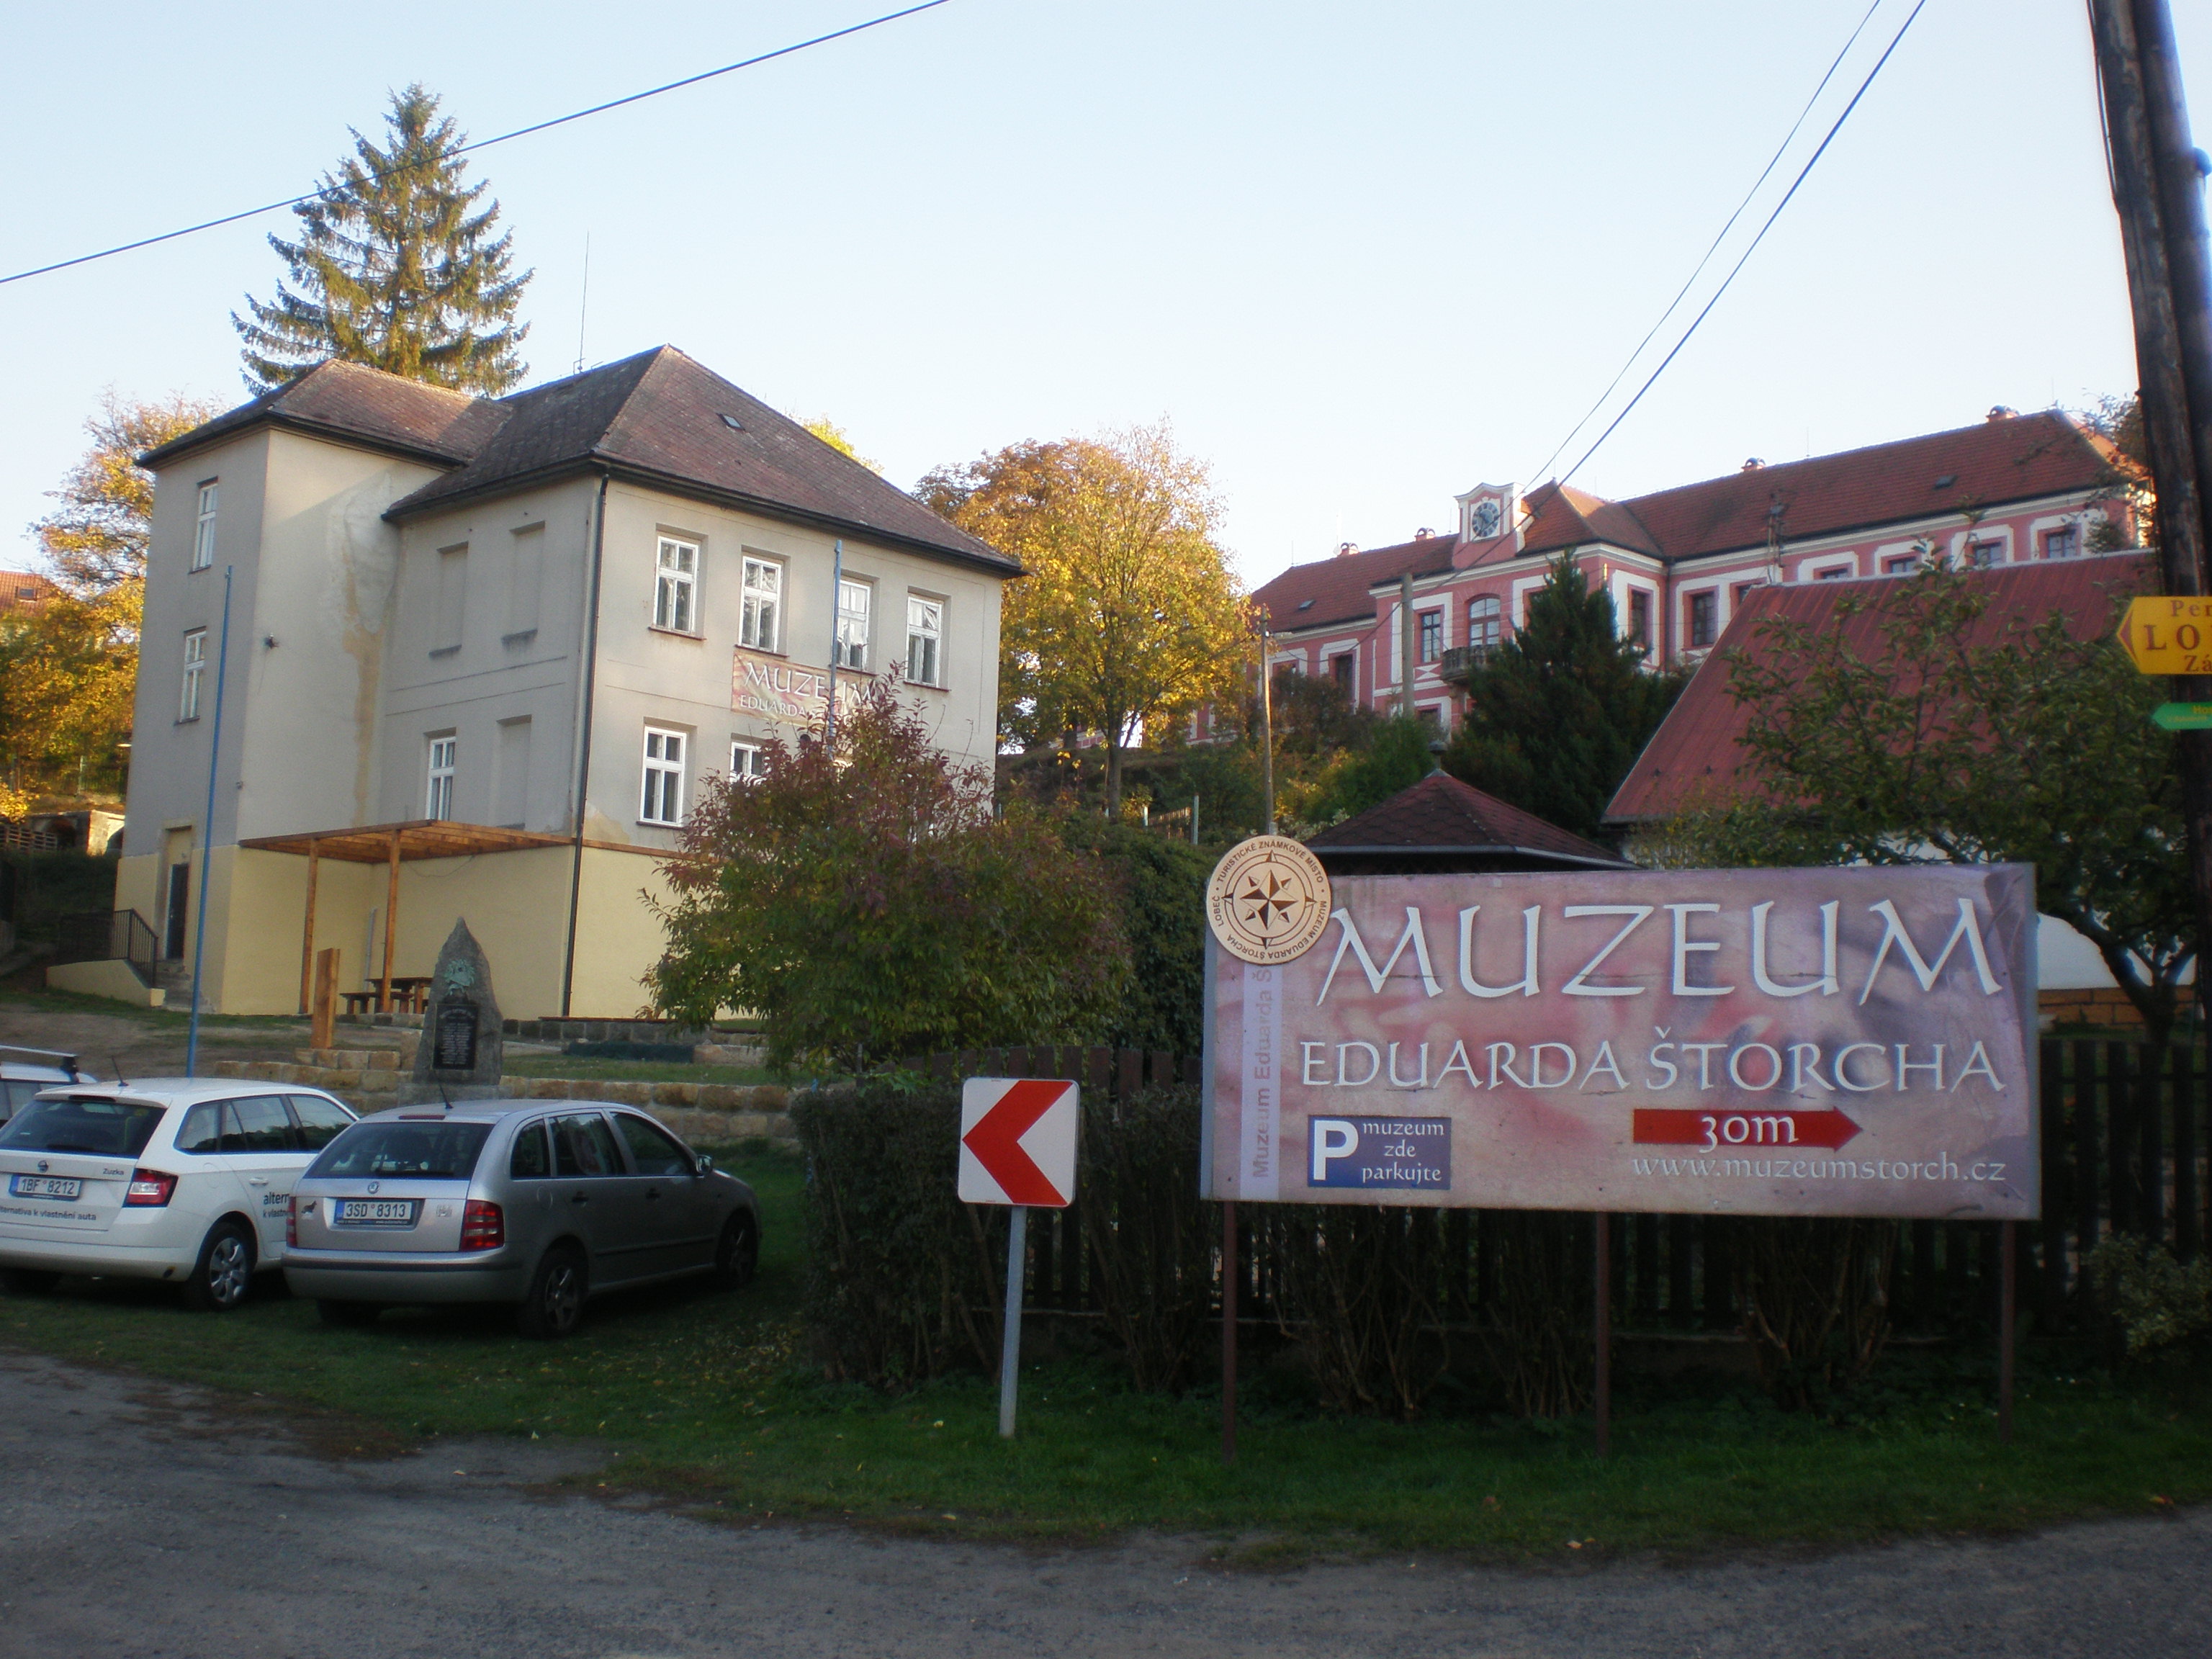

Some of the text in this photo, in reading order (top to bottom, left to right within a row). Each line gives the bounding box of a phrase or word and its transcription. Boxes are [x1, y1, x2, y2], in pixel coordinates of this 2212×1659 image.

[2144, 624, 2212, 650] LO
[739, 694, 806, 717] EDUARDA
[1217, 840, 1323, 884] TURISTICKÉ ZNÁMKOVÉ MÍSTO
[1212, 895, 1224, 927] LOBEČ
[1227, 901, 1327, 961] MUZEUM EDUARDA ŠTORCHA
[1316, 898, 2002, 1006] MUZEUM
[1254, 989, 1273, 1080] Eduarda
[1300, 1026, 2007, 1093] EDUARDA ŠTORCHA
[1252, 1087, 1270, 1178] Muzeum
[1384, 1139, 1416, 1157] zde
[1699, 1116, 1799, 1154] 30m
[1313, 1120, 1444, 1181] P muzeum
[1632, 1150, 2007, 1182] www.muzeumstorch.cz
[22, 1178, 76, 1195] 1BF 8212
[1362, 1161, 1442, 1184] parkujte
[346, 1203, 406, 1218] 3SD 8313
